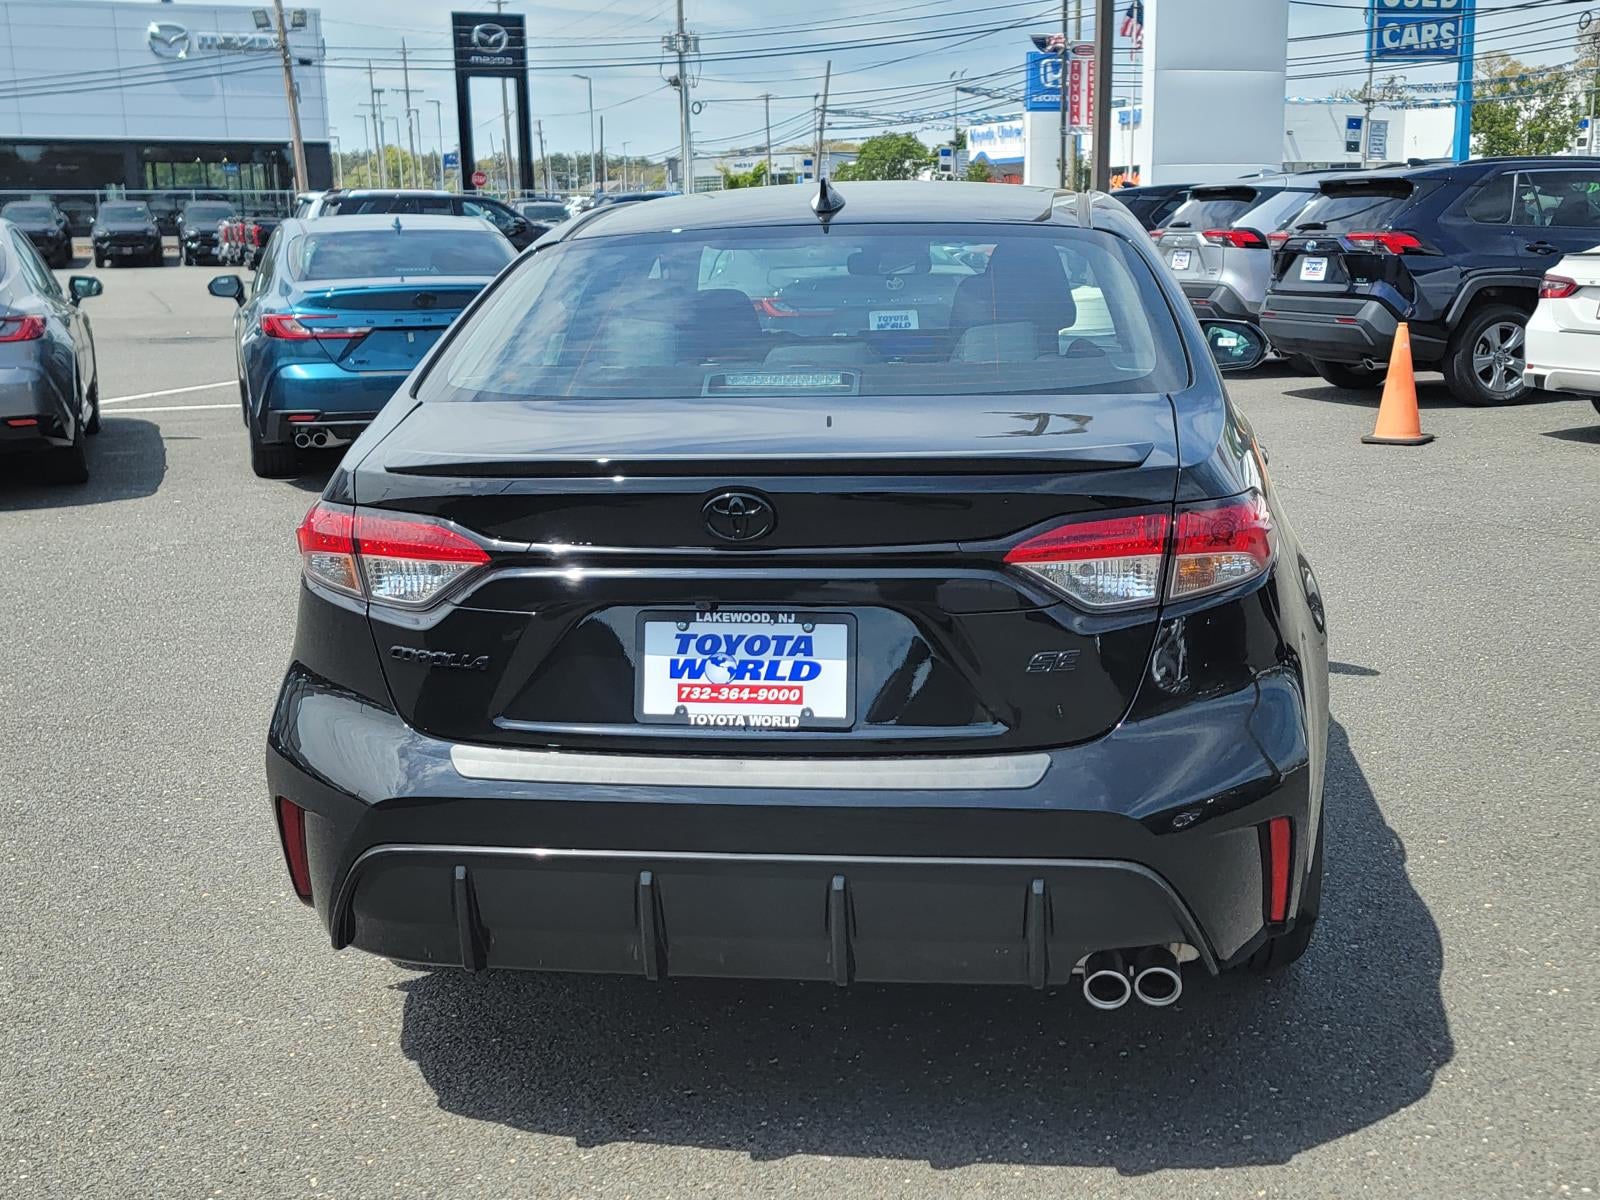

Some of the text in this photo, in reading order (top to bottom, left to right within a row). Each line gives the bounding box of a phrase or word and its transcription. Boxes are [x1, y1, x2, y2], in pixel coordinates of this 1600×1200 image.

[1383, 22, 1455, 50] CARS
[1032, 94, 1061, 102] HON
[1071, 62, 1081, 123] TOYOTA
[696, 612, 796, 624] LAKEWOOD, NJ
[675, 633, 814, 657] TOYOTA
[390, 645, 489, 670] COROLLA
[1025, 649, 1081, 673] SE
[669, 658, 822, 684] WORLD
[680, 686, 801, 701] 732-364-9000
[688, 714, 800, 728] TOYOTA WORLD
